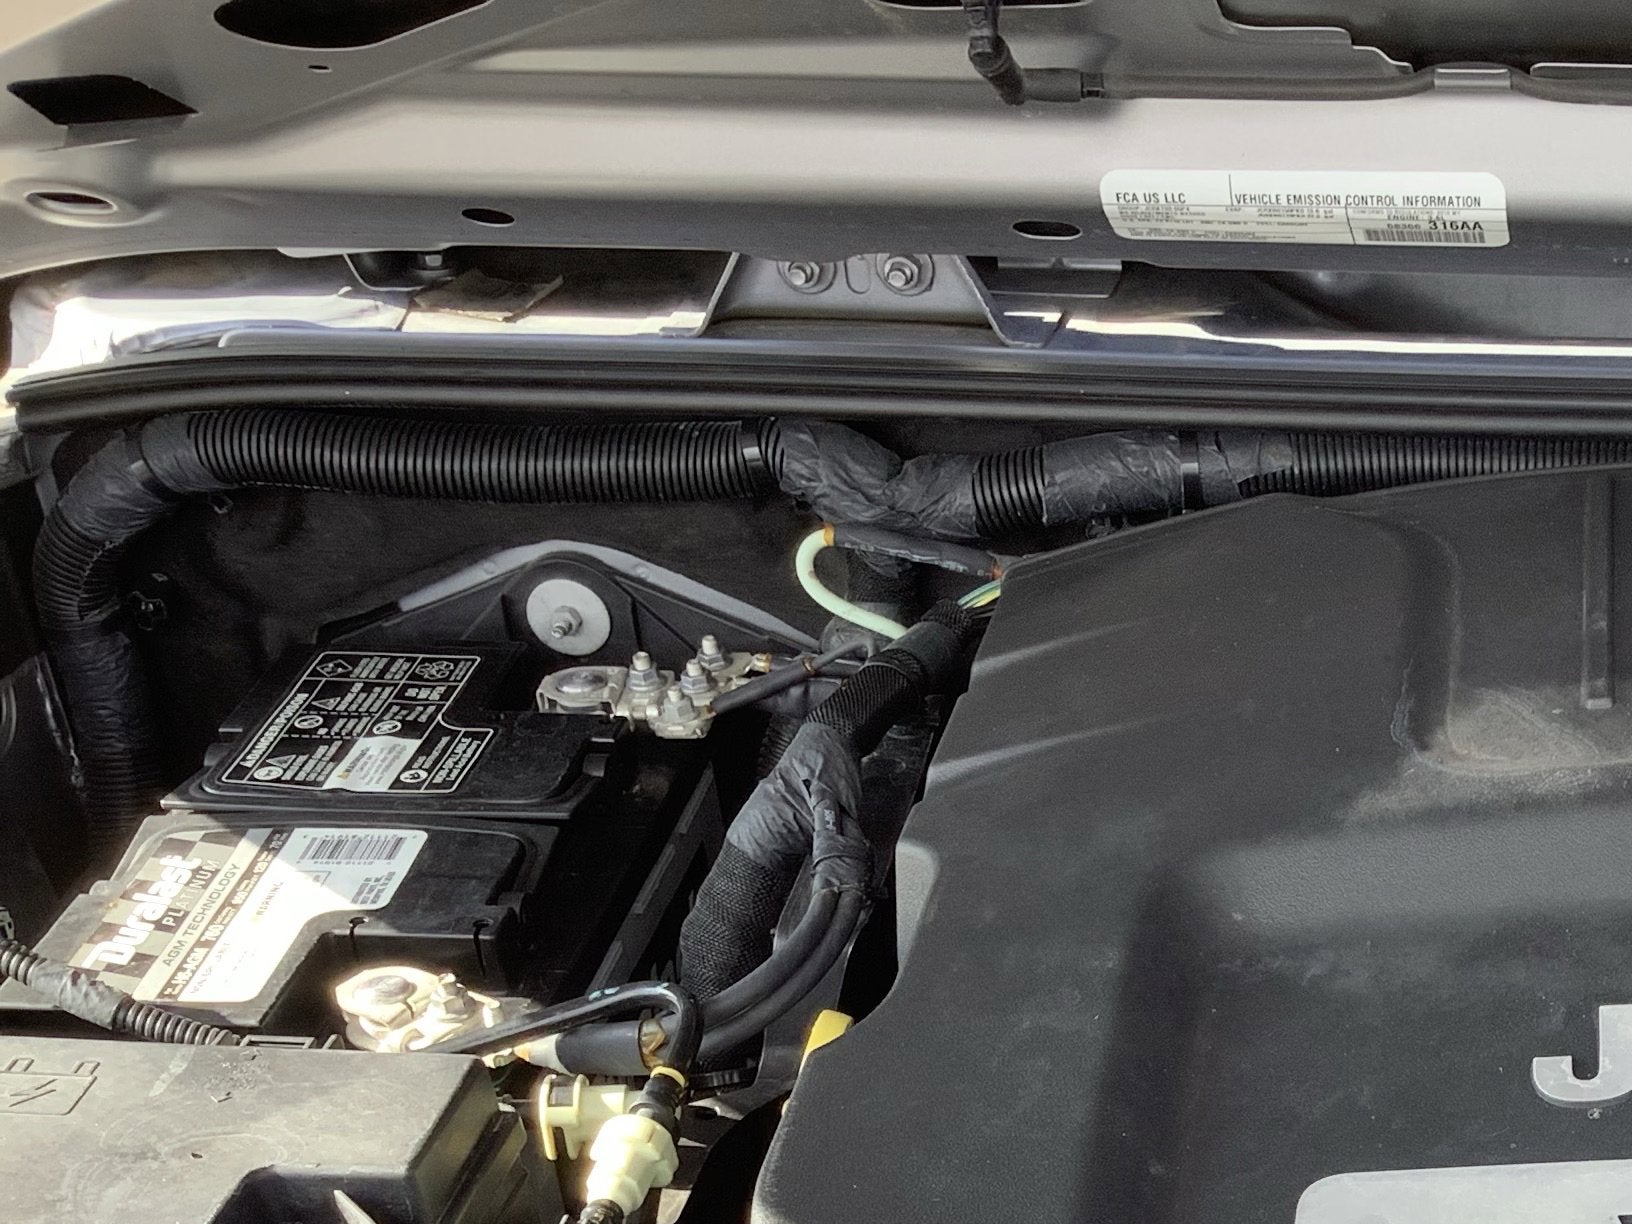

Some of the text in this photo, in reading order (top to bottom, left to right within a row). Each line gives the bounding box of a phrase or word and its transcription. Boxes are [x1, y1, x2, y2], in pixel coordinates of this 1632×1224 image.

[1115, 192, 1186, 204] FCA US LLC
[1234, 194, 1481, 208] VEHICLE EMISSION CONTROL INFORMATION
[1428, 220, 1484, 231] 316AA
[80, 854, 203, 969] Duralast
[162, 859, 221, 927] PLATINUM
[161, 939, 187, 967] AGM
[182, 863, 241, 937] TECHNOLOGY
